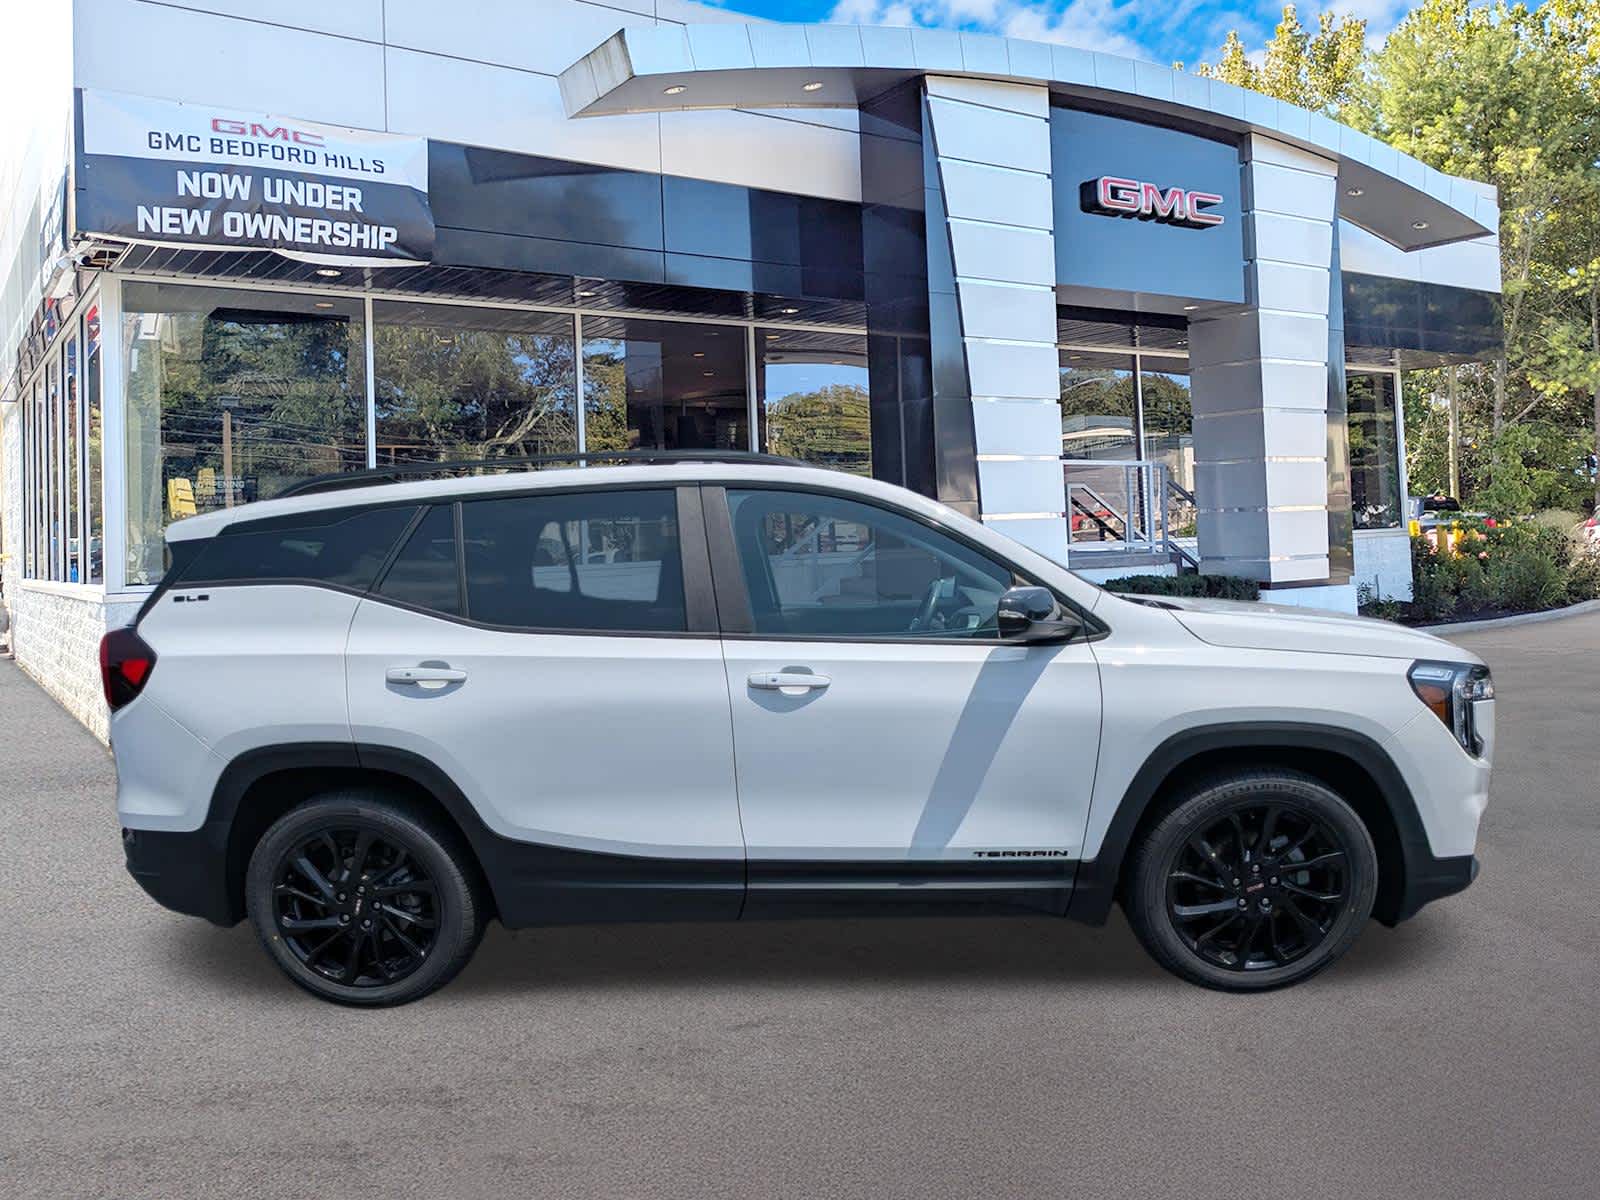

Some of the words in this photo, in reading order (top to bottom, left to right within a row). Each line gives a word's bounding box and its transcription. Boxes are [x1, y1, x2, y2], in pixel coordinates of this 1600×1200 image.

[148, 131, 201, 153] GMC
[210, 138, 316, 164] BEDFORD
[325, 154, 385, 174] HILLS
[211, 118, 325, 147] GMC
[177, 170, 252, 201] NOW
[263, 177, 364, 212] UNDER
[1098, 175, 1225, 224] GMC
[137, 205, 212, 236] NEW
[223, 211, 398, 250] OWNERSHIP
